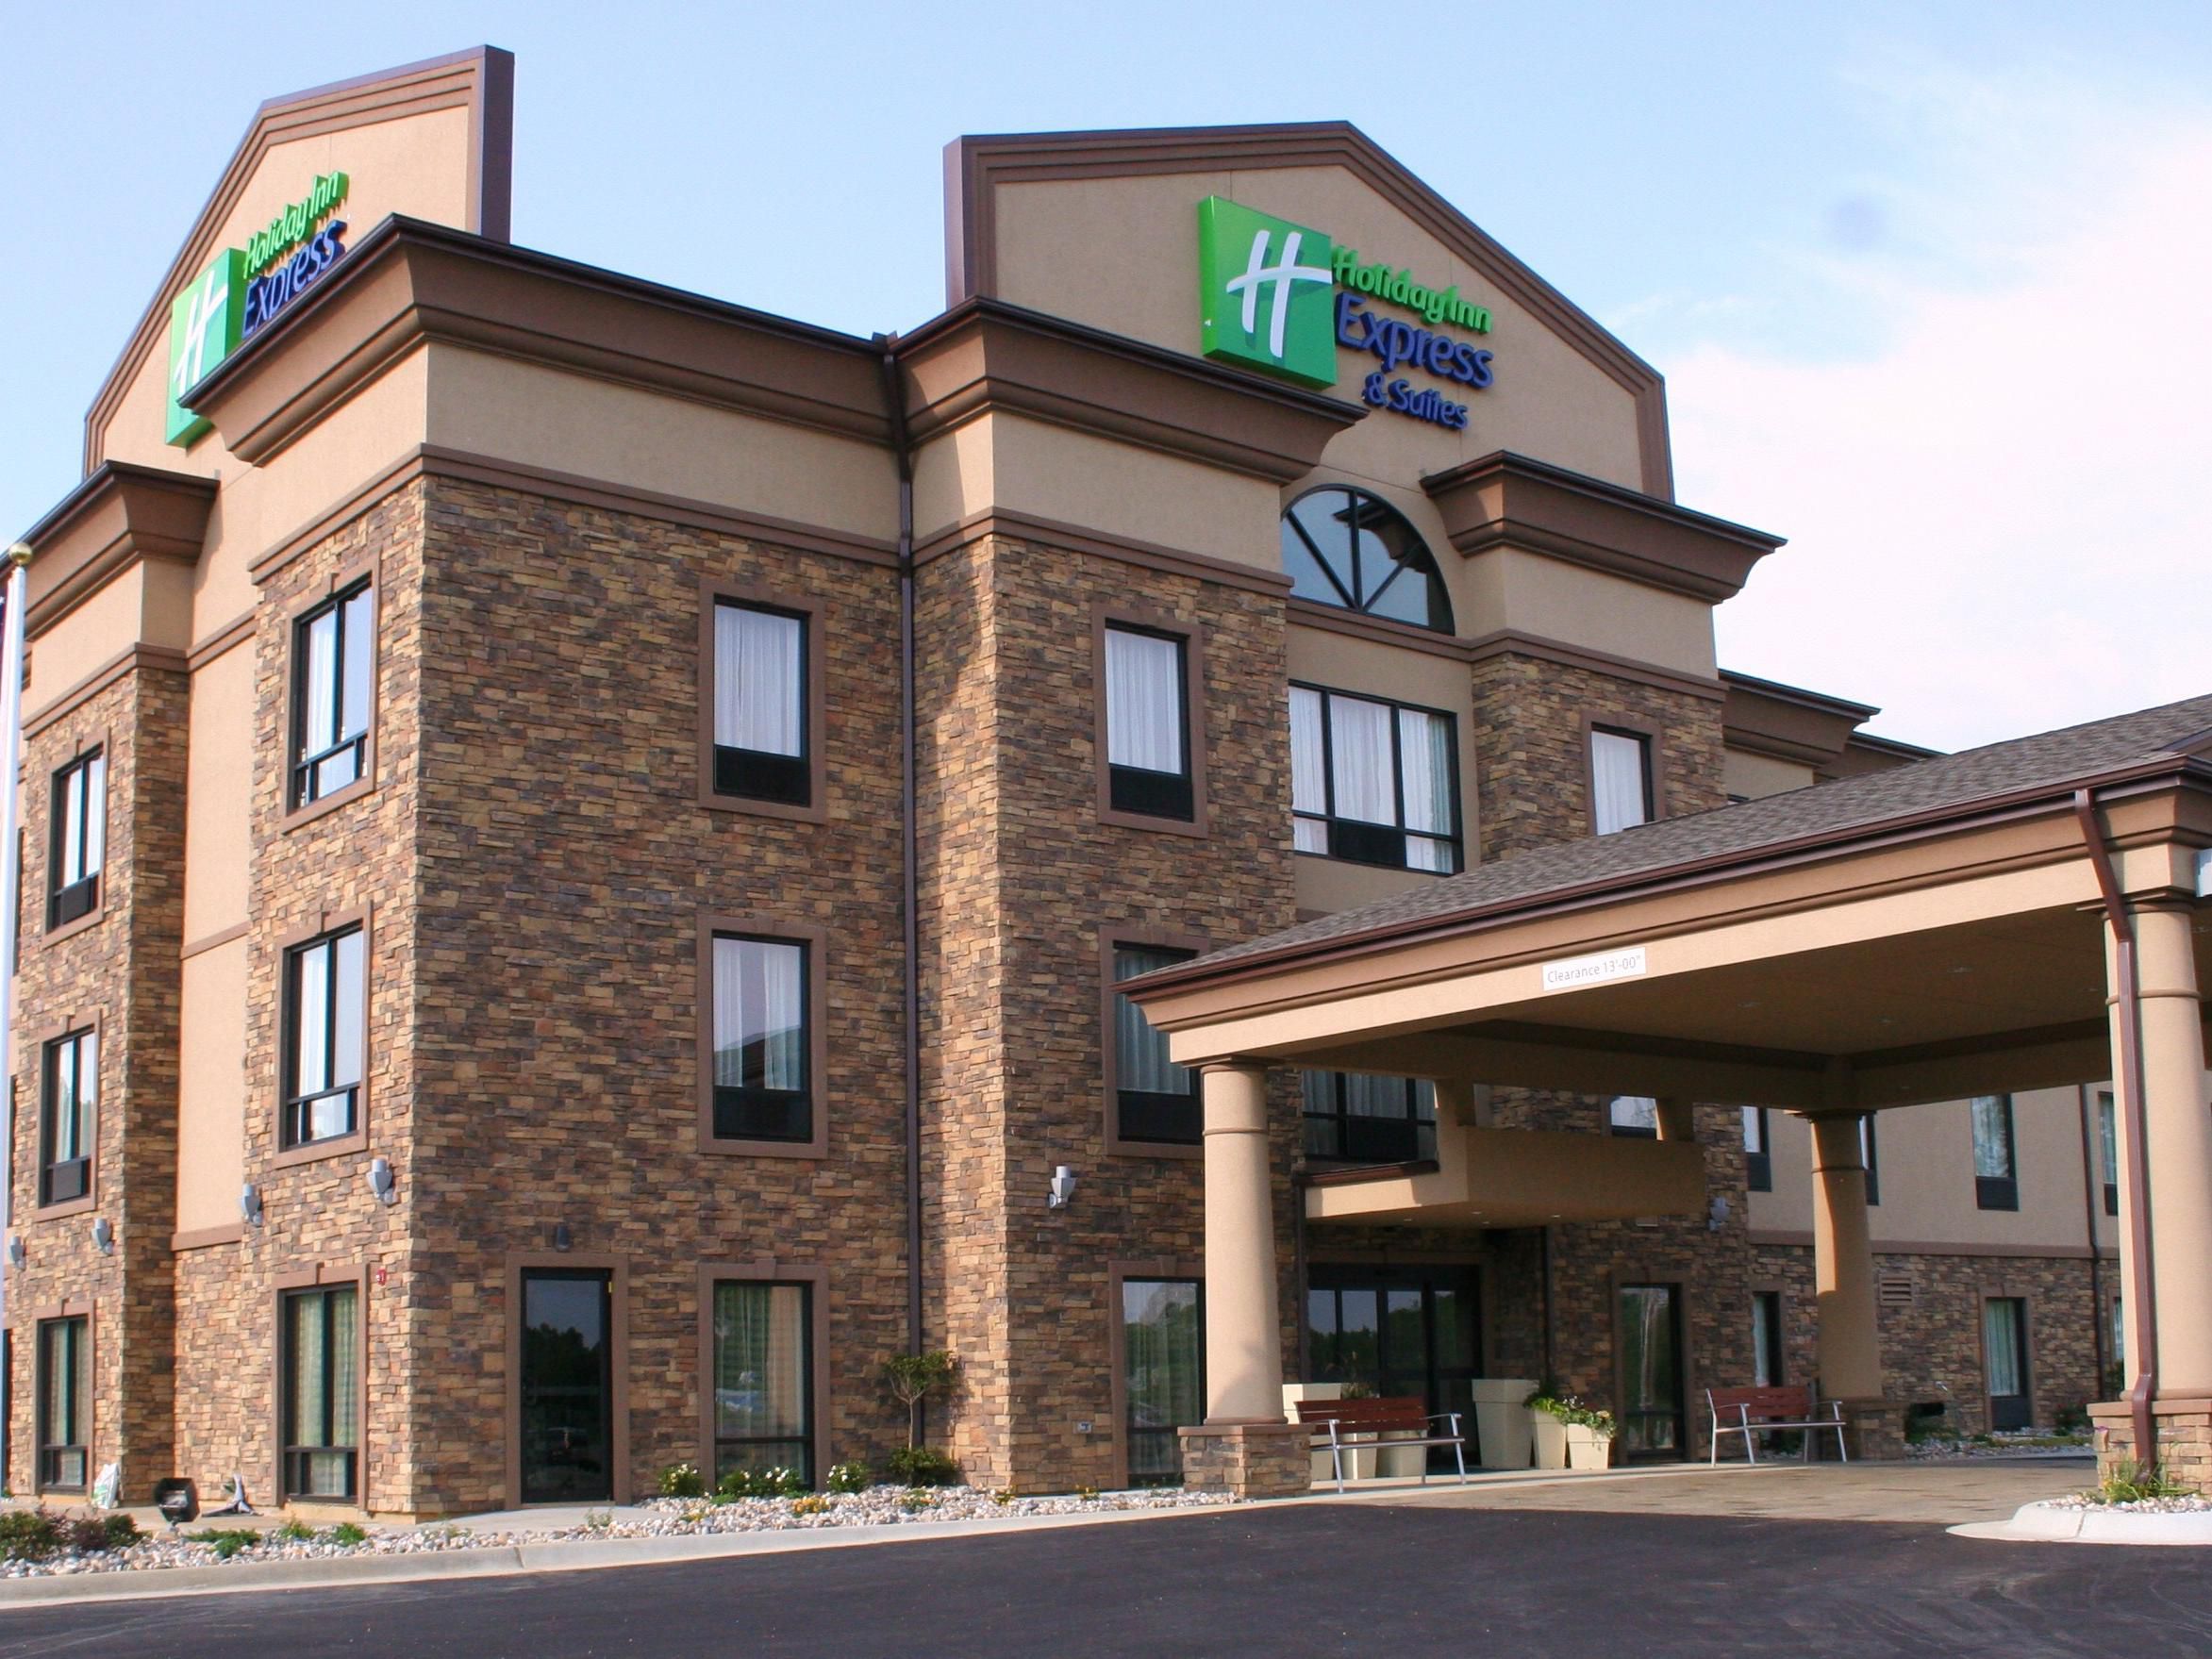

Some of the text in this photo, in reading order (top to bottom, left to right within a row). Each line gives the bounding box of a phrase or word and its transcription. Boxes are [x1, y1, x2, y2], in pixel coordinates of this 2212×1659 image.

[242, 171, 347, 280] Holiday Inn
[242, 219, 346, 340] Express
[1332, 245, 1492, 334] Holiday Inn
[1335, 292, 1494, 389] Express
[1363, 372, 1468, 429] & Suites
[1547, 965, 1601, 983] Clearance
